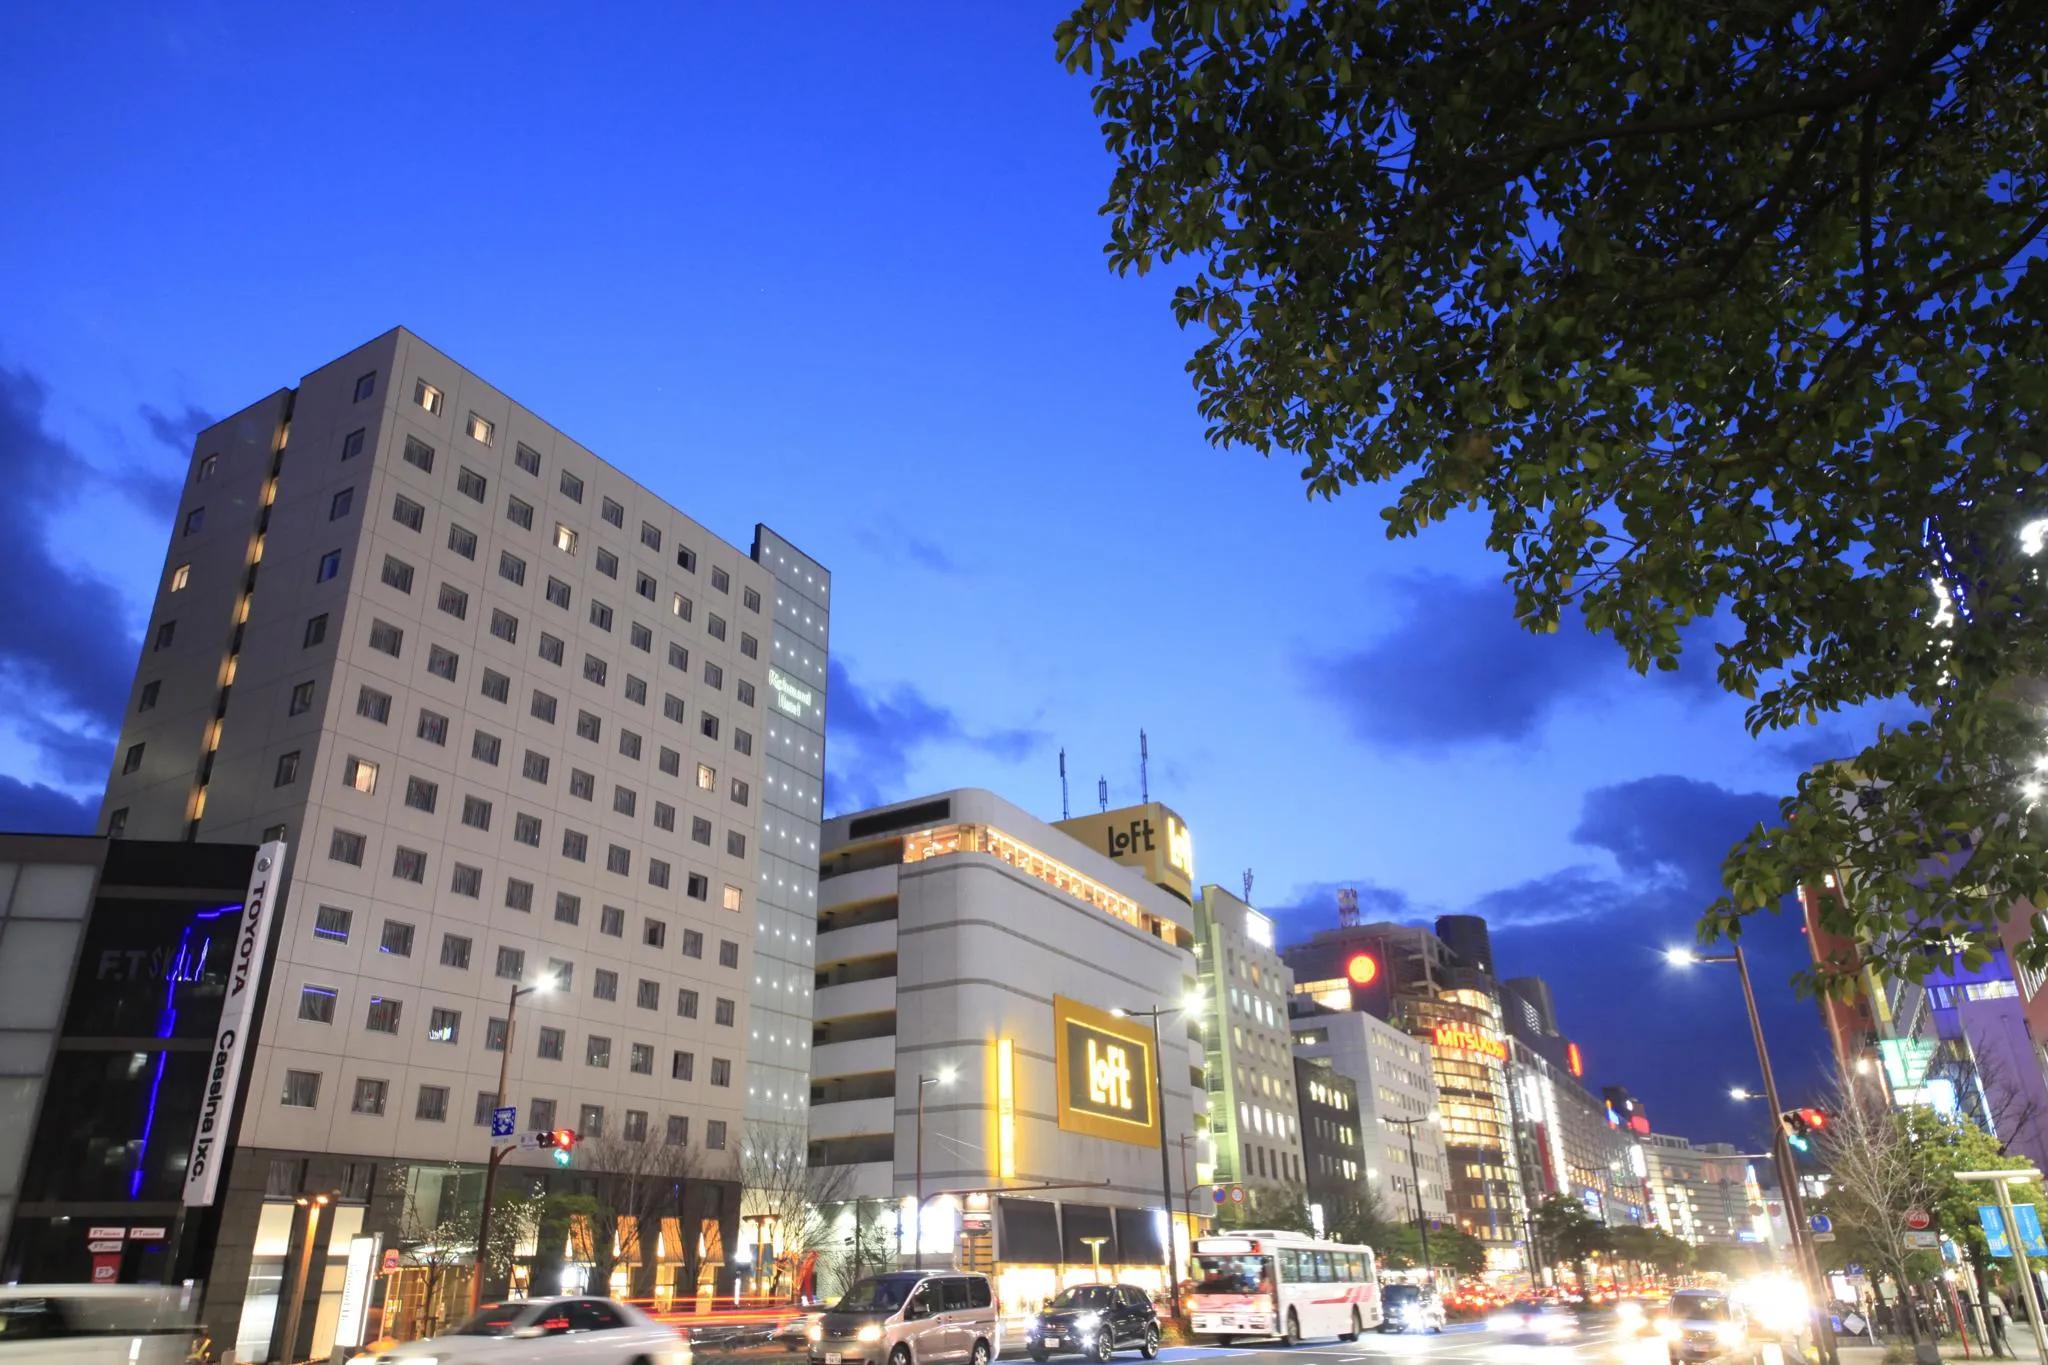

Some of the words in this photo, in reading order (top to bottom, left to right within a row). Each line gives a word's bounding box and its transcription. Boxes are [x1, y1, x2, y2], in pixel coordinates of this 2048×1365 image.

[231, 880, 267, 998] TOYOTA
[200, 1029, 236, 1134] Cassina
[1435, 1028, 1508, 1062] MITSUKO
